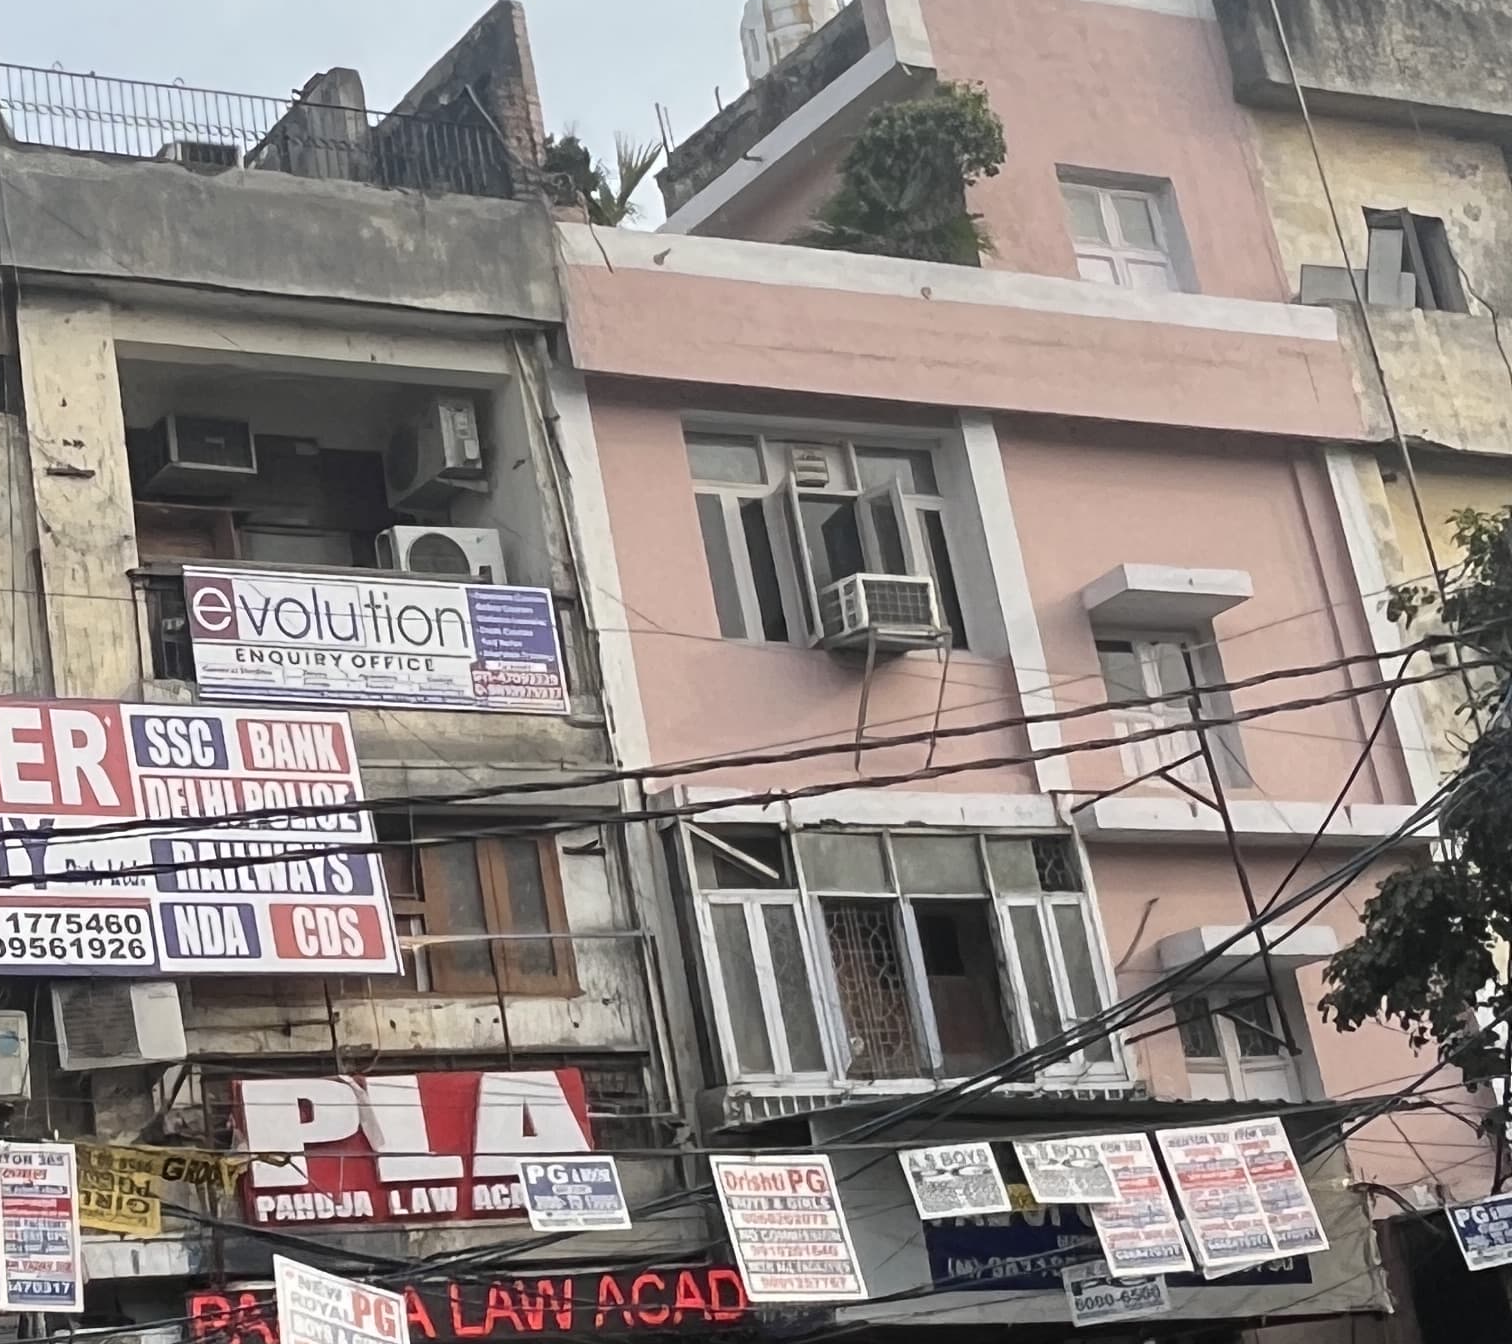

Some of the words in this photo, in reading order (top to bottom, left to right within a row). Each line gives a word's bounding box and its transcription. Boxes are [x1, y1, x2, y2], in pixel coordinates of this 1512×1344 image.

[192, 585, 468, 648] evolution
[235, 648, 342, 668] ENQUIRY
[351, 653, 435, 673] OFFICE
[145, 718, 214, 768] SSC
[250, 722, 340, 772] BANK
[144, 777, 238, 824] DELHI
[244, 782, 358, 832] POLICE
[172, 841, 355, 894] RAILWAYS
[174, 906, 250, 957] NDA
[292, 906, 365, 957] CDS
[241, 1071, 590, 1187] PLA
[526, 1164, 569, 1184] PG
[786, 1168, 826, 1194] PG
[388, 1186, 458, 1216] LAW
[1454, 1205, 1490, 1229] PG
[351, 1289, 397, 1338] PG
[450, 1277, 574, 1337] LAW
[595, 1269, 746, 1330] ACAD
